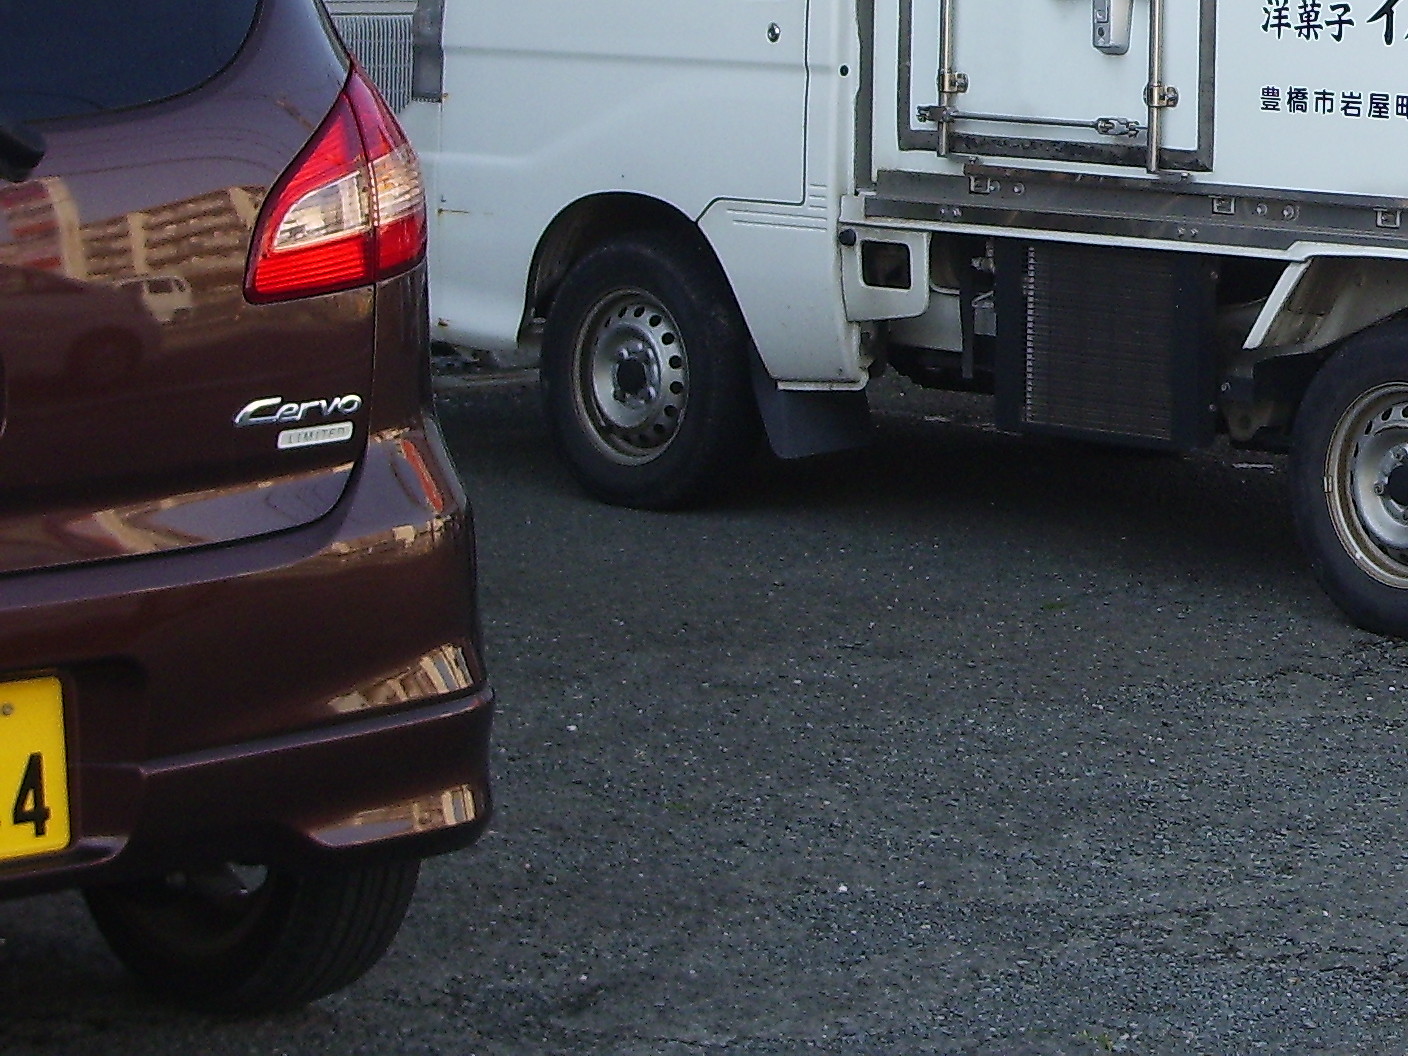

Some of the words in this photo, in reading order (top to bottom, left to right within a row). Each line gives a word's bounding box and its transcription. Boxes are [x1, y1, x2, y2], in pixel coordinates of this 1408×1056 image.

[232, 393, 363, 428] Cervo
[286, 426, 347, 445] LIMITED
[12, 750, 51, 838] 4
